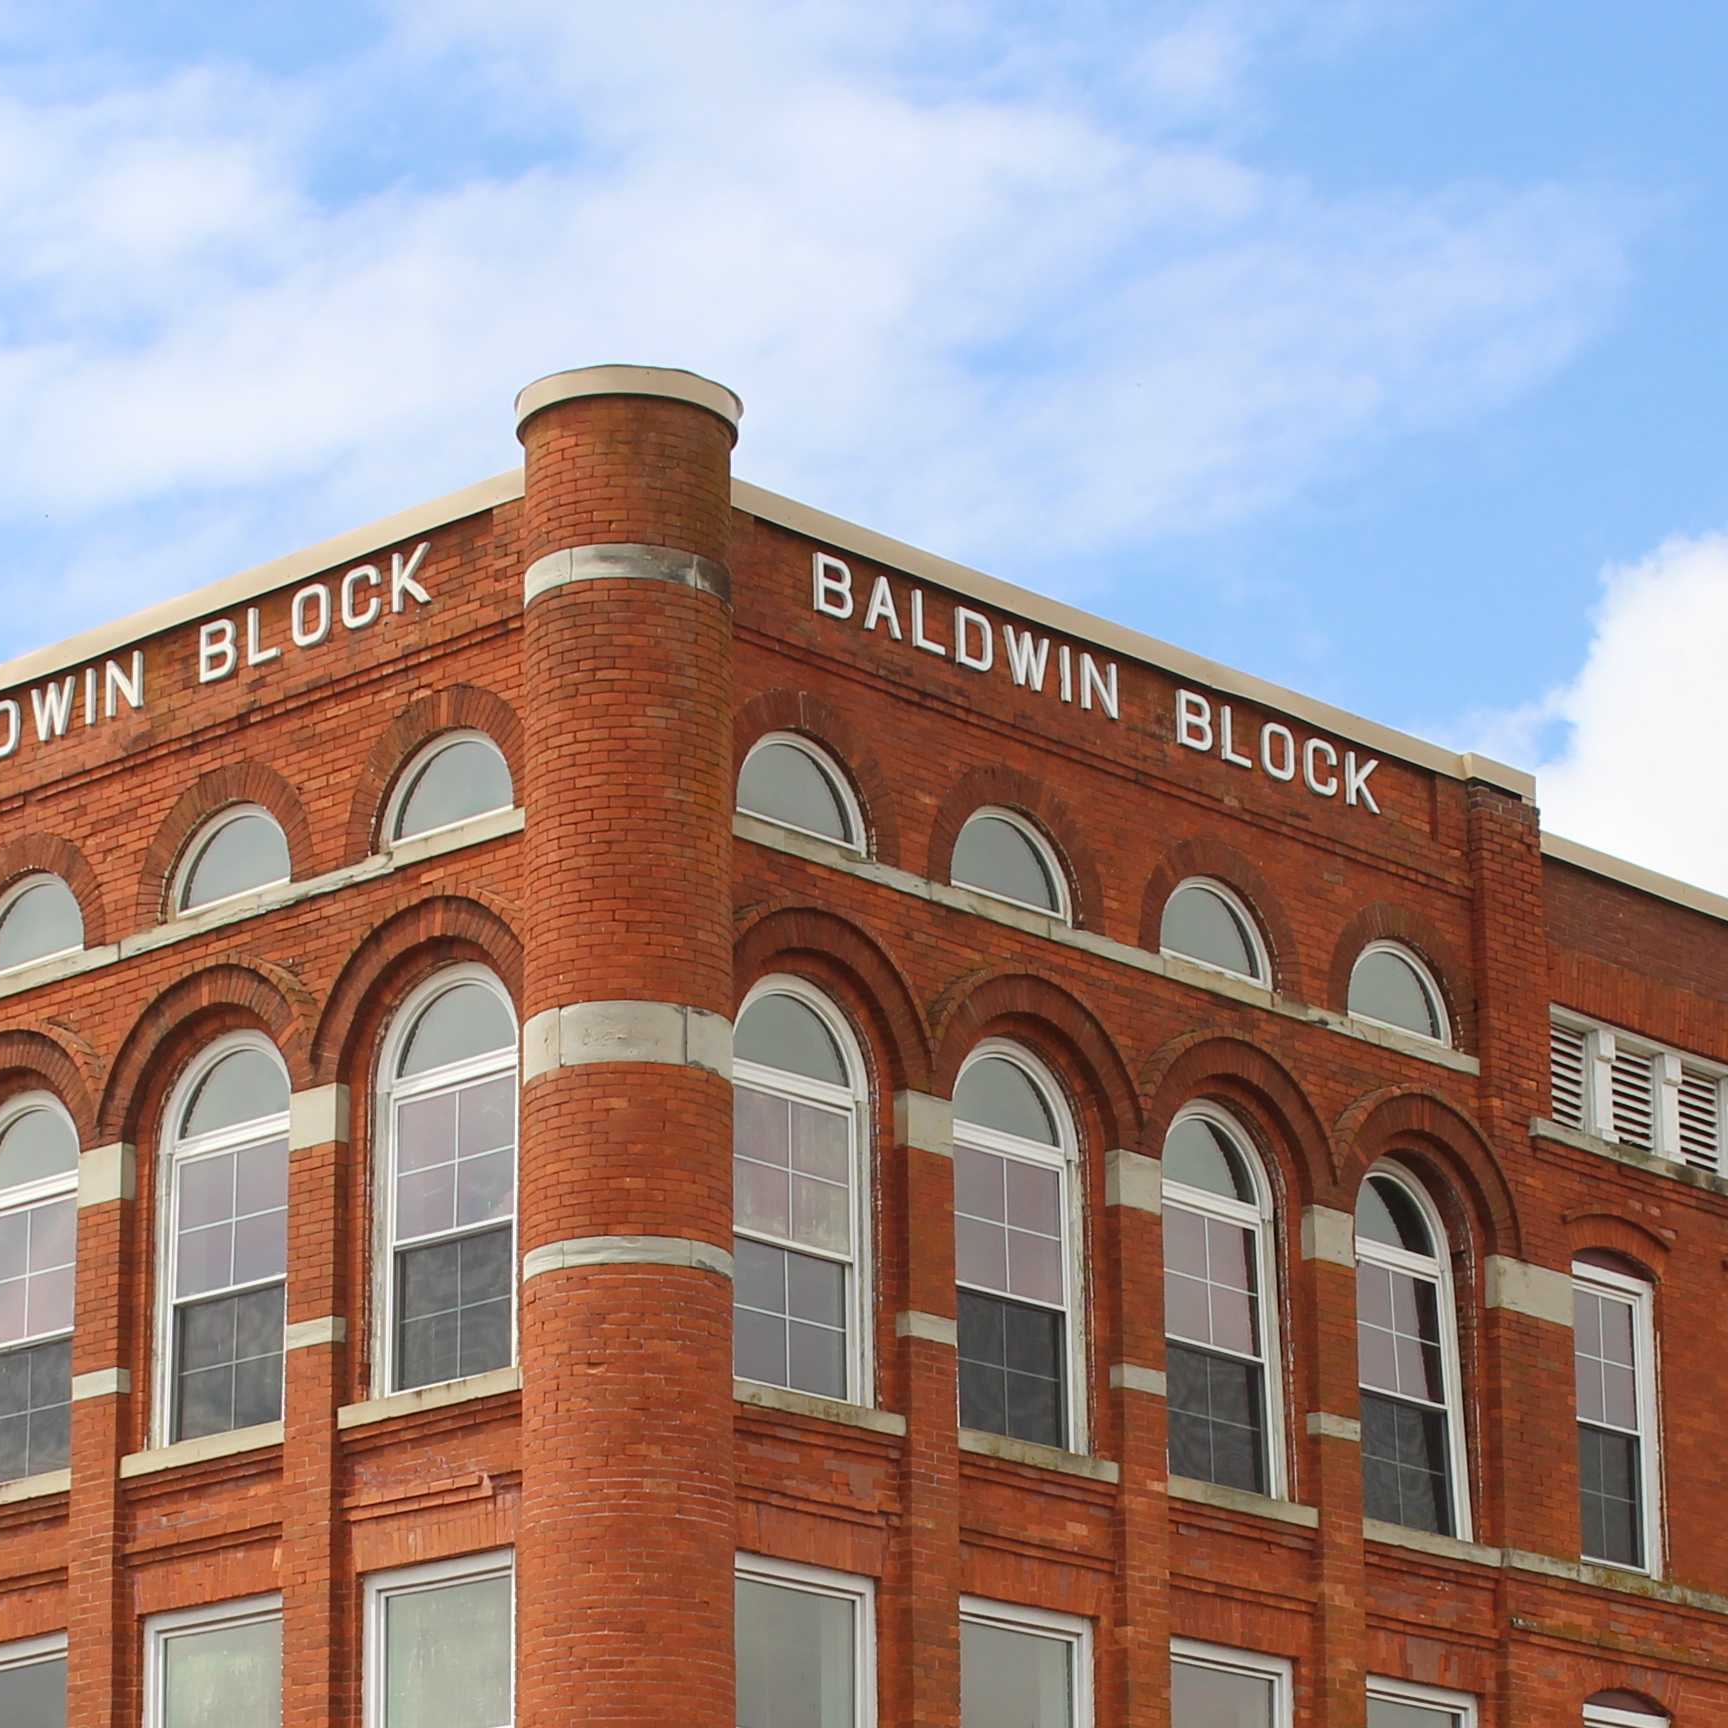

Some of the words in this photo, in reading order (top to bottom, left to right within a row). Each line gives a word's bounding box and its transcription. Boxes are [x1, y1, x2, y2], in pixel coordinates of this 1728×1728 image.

[198, 541, 432, 684] BLOCK
[813, 552, 1119, 720] BALDWIN
[1175, 688, 1380, 814] BLOCK
